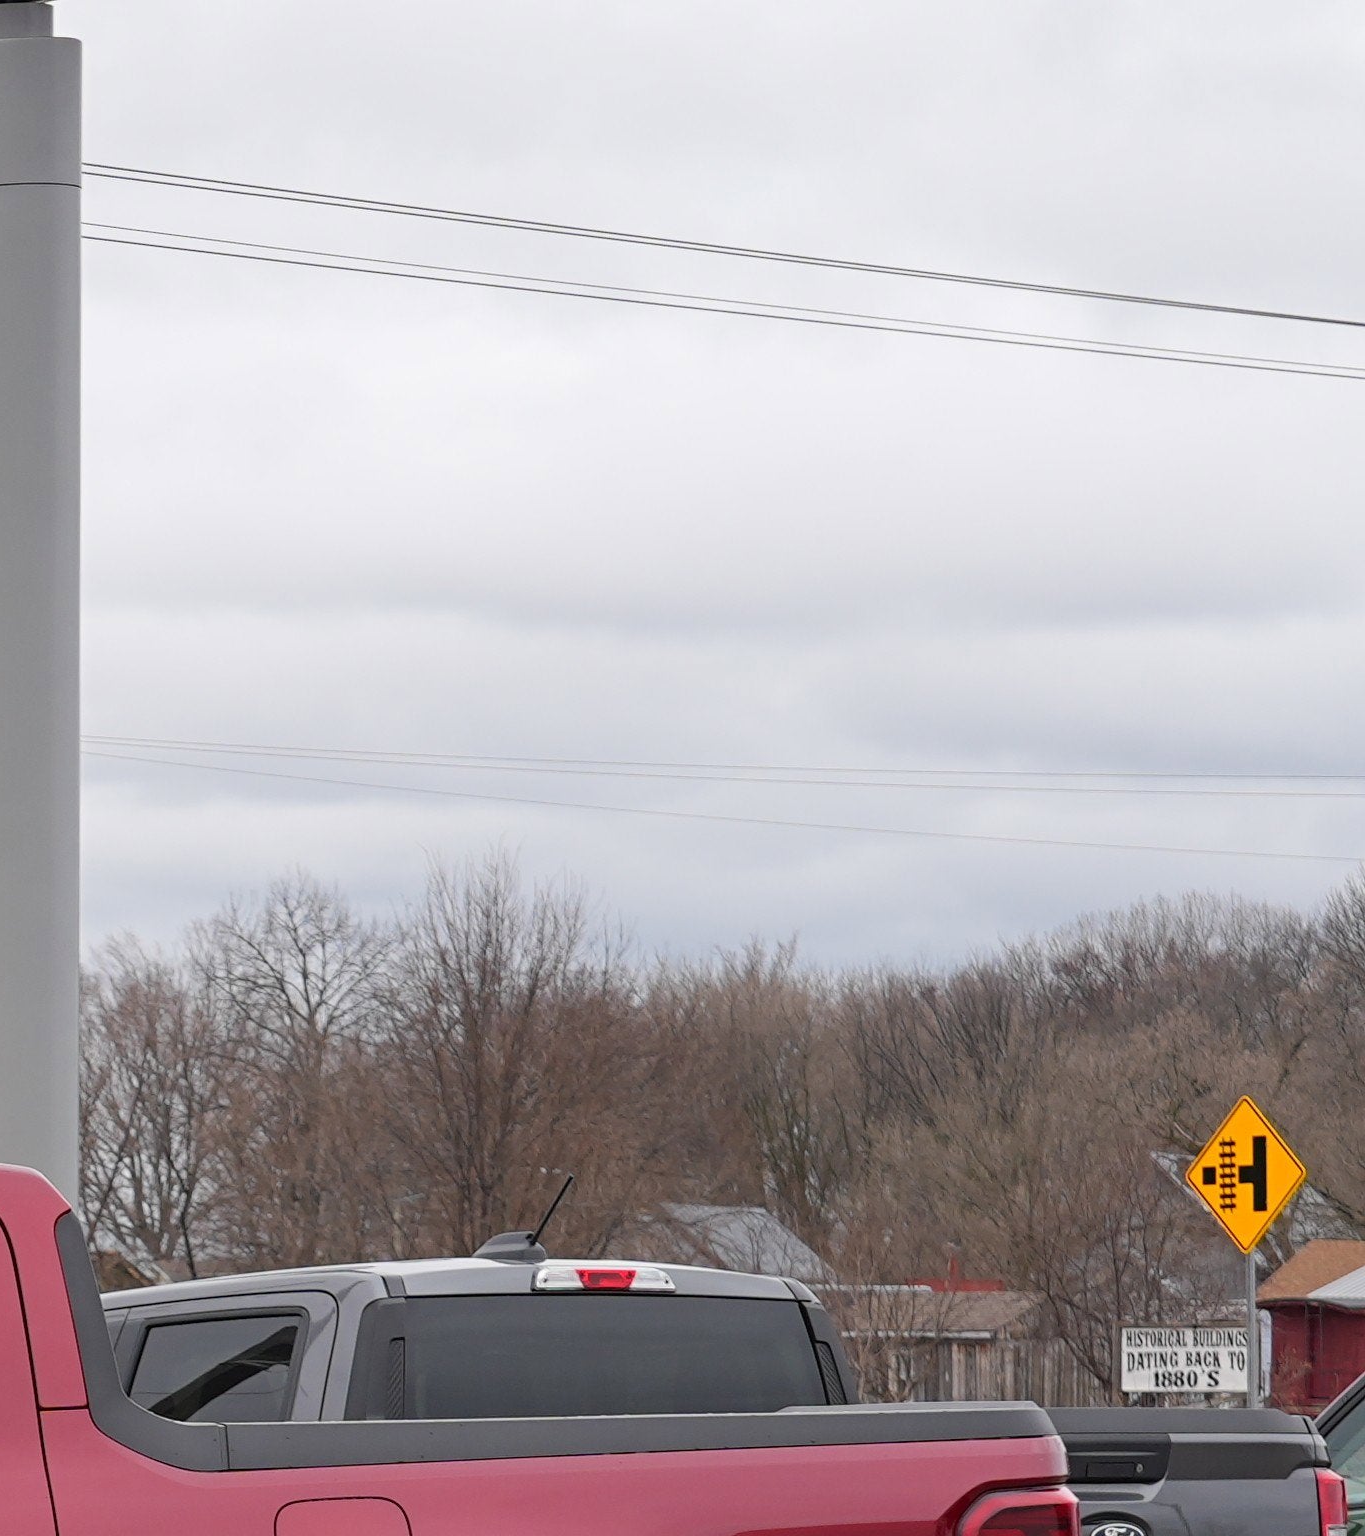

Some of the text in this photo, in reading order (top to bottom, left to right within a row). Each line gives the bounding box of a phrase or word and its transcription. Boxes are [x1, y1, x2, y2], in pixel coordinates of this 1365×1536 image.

[1126, 1329, 1248, 1348] HISTORICAL BUILDINGS
[1127, 1350, 1246, 1372] DATING BACK TO
